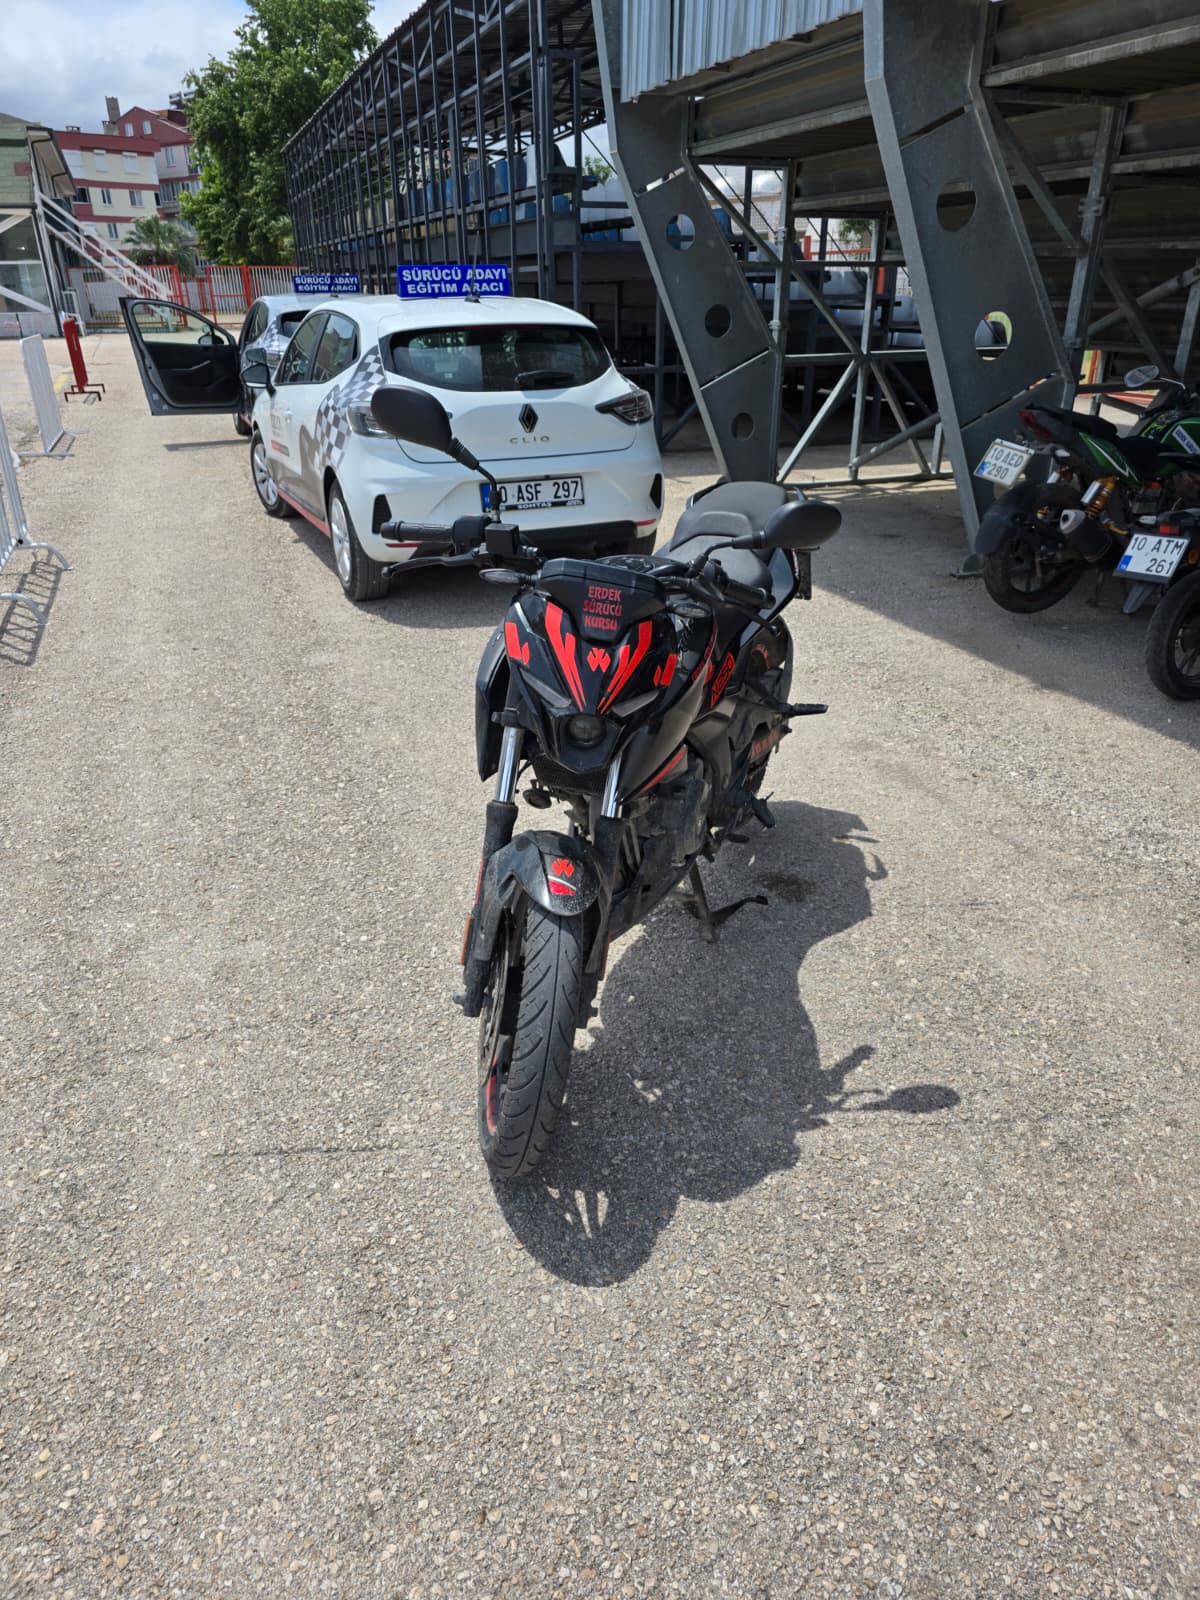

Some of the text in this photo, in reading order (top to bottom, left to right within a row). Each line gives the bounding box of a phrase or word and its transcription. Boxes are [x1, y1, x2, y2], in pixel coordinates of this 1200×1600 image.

[402, 266, 507, 281] SÜRÜCÜ ADAYI
[407, 281, 504, 294] EĞİTİM ARACI
[509, 435, 550, 444] CLIO
[987, 463, 1009, 479] 290
[516, 483, 542, 502] ASF
[552, 480, 579, 499] 297
[1131, 536, 1185, 556] 10 ATM
[1145, 558, 1174, 575] 261
[588, 585, 621, 602] ERDEK
[583, 599, 622, 617] SÜRÜCÜ
[584, 615, 618, 631] KURSU
